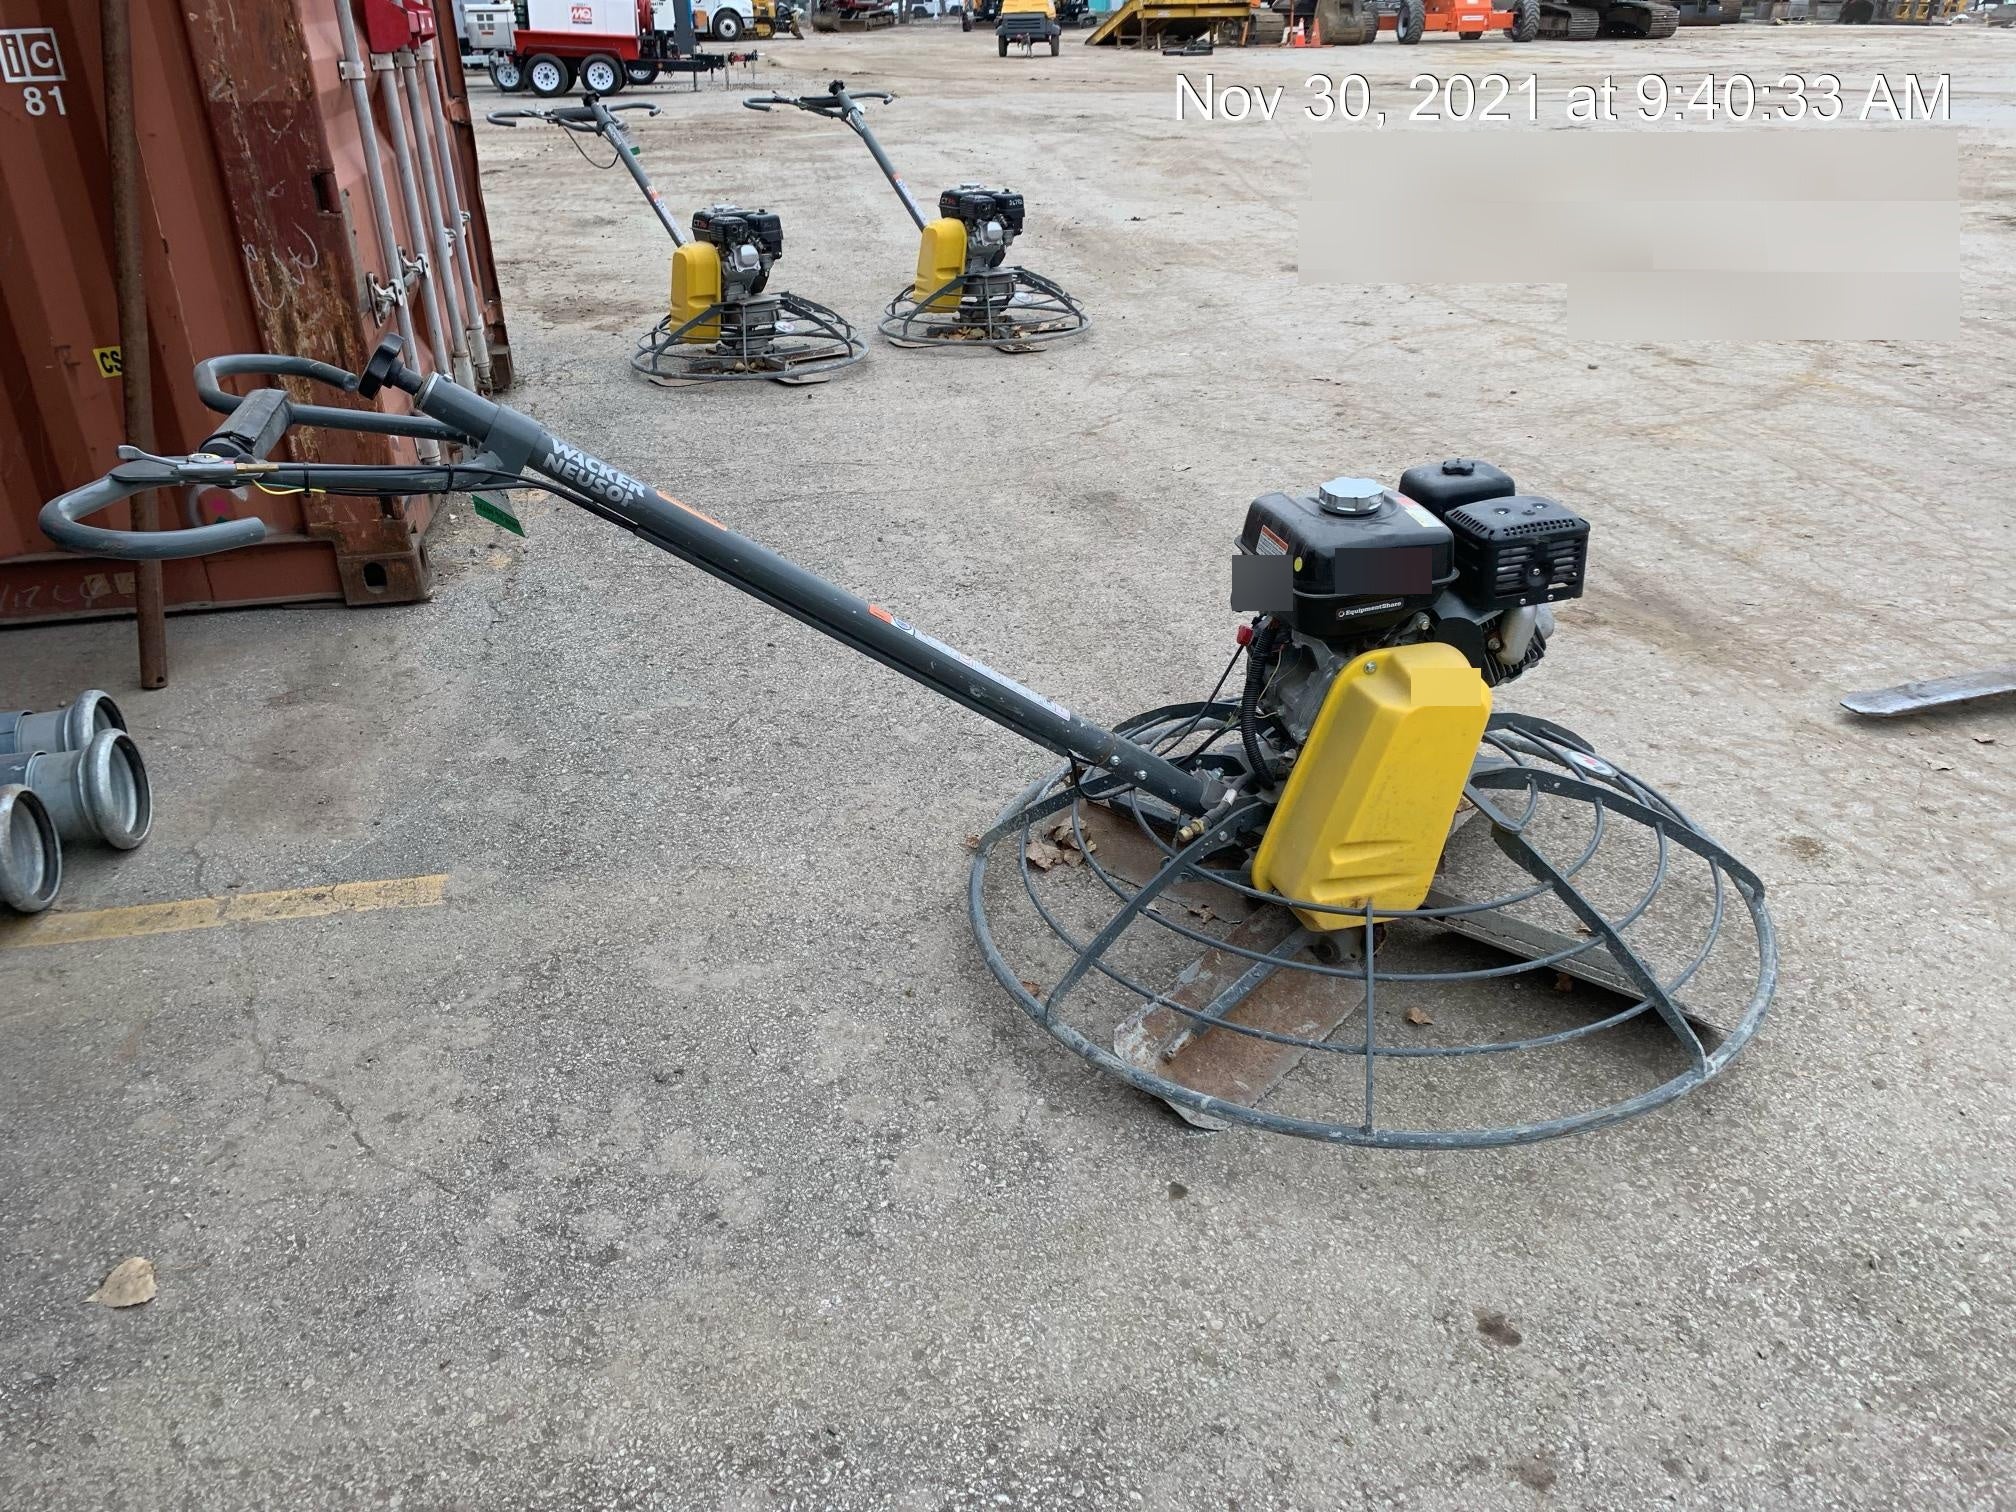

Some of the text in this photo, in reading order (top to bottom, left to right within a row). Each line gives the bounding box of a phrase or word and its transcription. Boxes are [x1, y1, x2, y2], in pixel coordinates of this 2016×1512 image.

[572, 6, 592, 19] MQ
[23, 86, 66, 116] 81
[551, 437, 646, 498] WACKER
[1345, 601, 1402, 616] EquipmentShare
